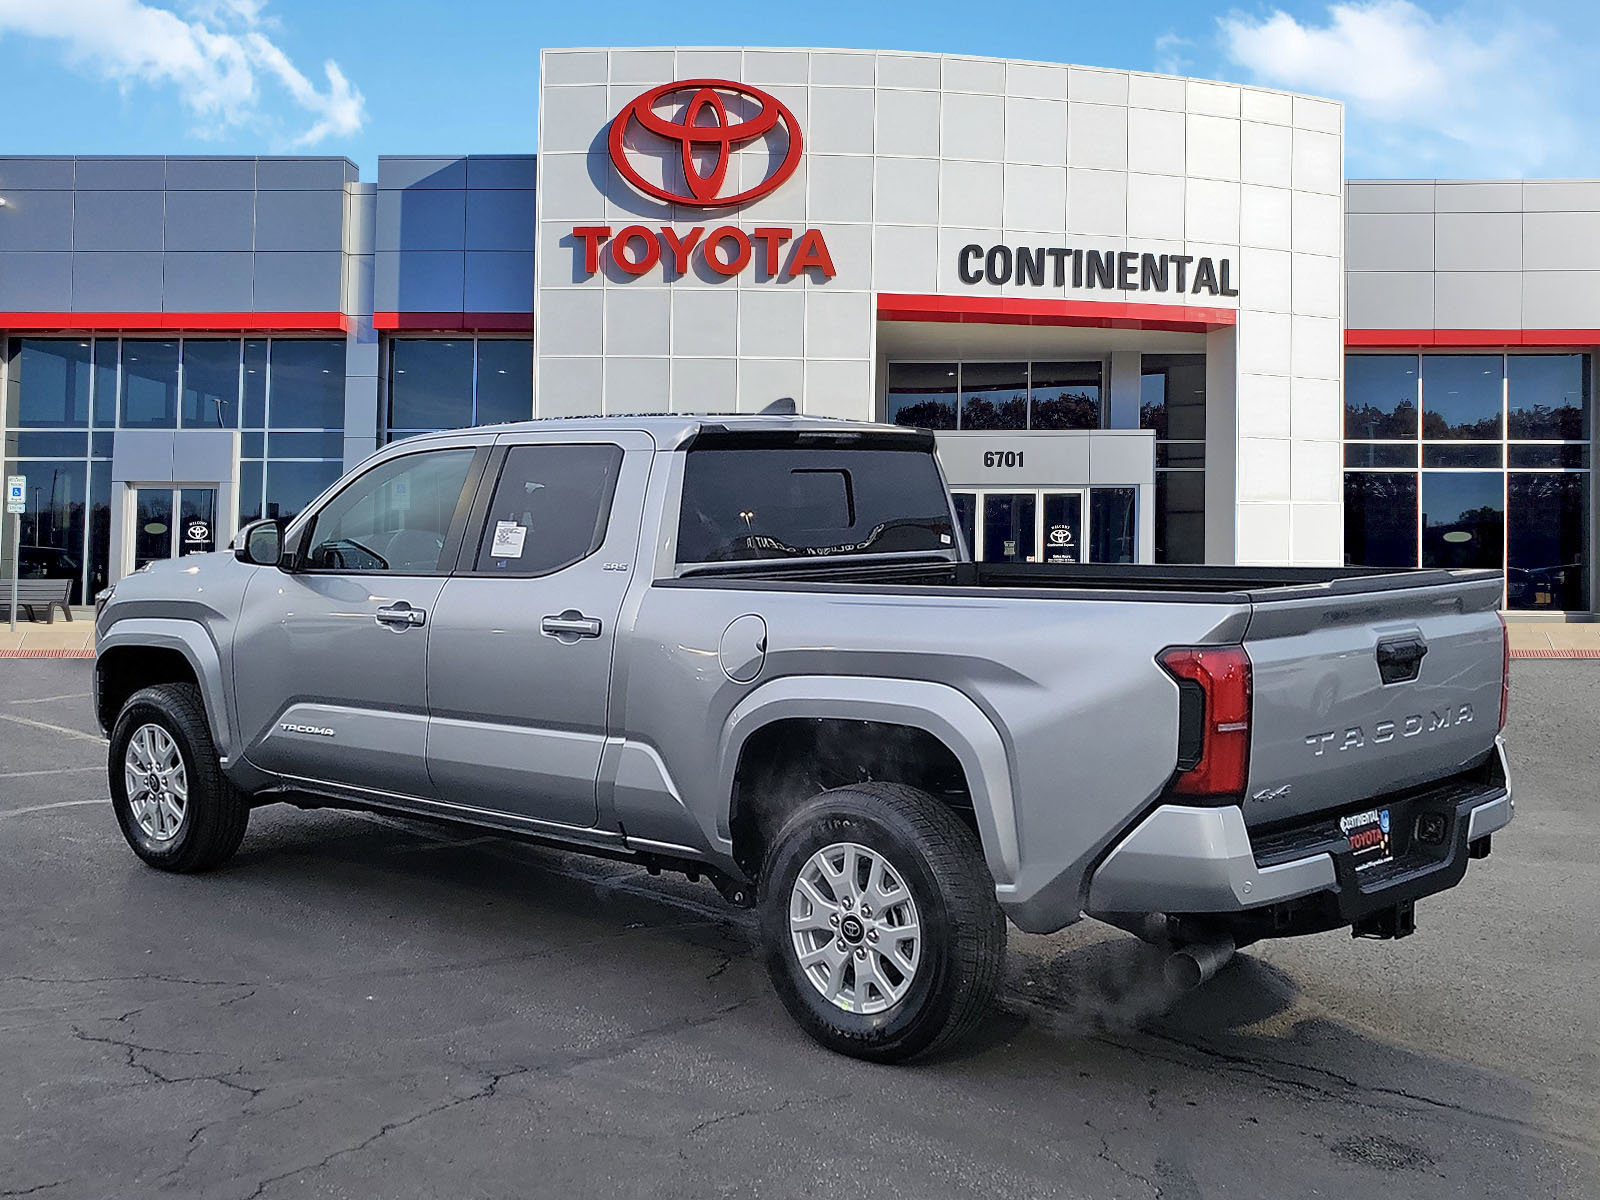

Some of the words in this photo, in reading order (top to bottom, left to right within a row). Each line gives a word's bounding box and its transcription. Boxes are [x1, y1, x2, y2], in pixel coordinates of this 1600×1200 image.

[572, 225, 837, 277] TOYOTA
[957, 244, 1239, 297] CONTINENTAL
[983, 451, 1024, 468] 6701
[280, 723, 336, 736] TACOMA
[1304, 703, 1475, 756] TACOMA
[1349, 829, 1383, 849] TOYOTA
